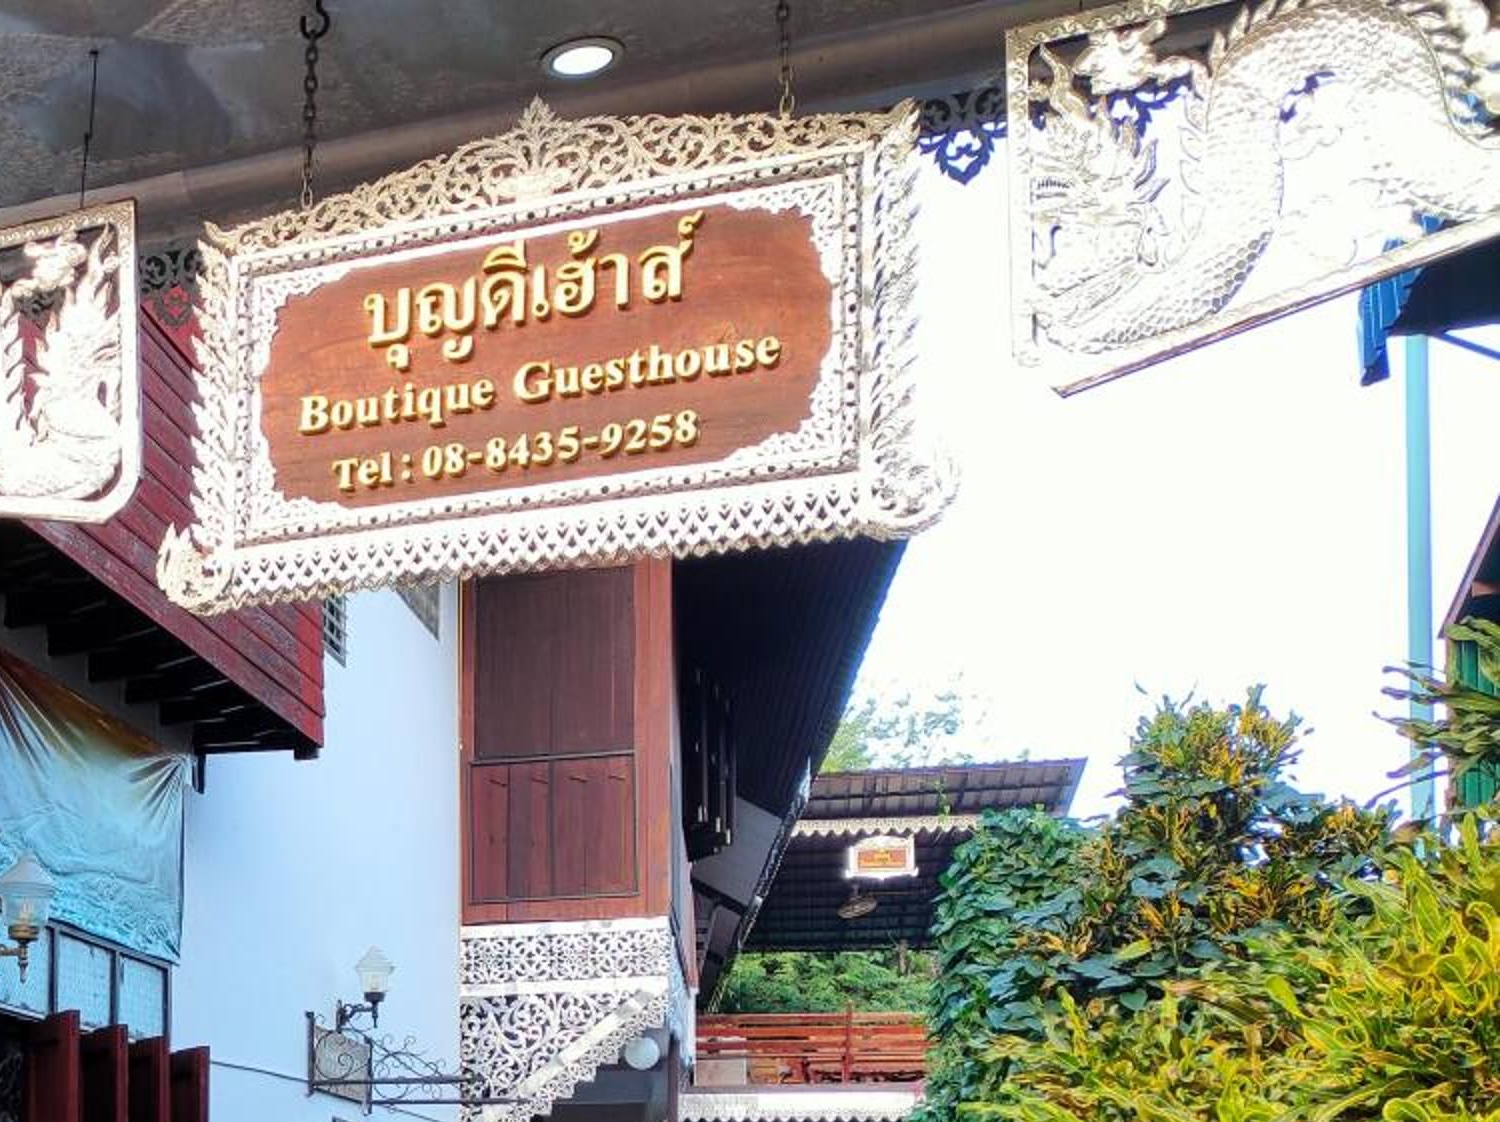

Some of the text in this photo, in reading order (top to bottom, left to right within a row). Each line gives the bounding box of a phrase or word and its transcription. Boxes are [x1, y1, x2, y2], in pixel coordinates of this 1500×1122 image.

[364, 210, 705, 368] บุญดีเฮ้าส์
[298, 332, 782, 436] Boutique Guesthouse
[421, 410, 700, 480] 08-8435-9258
